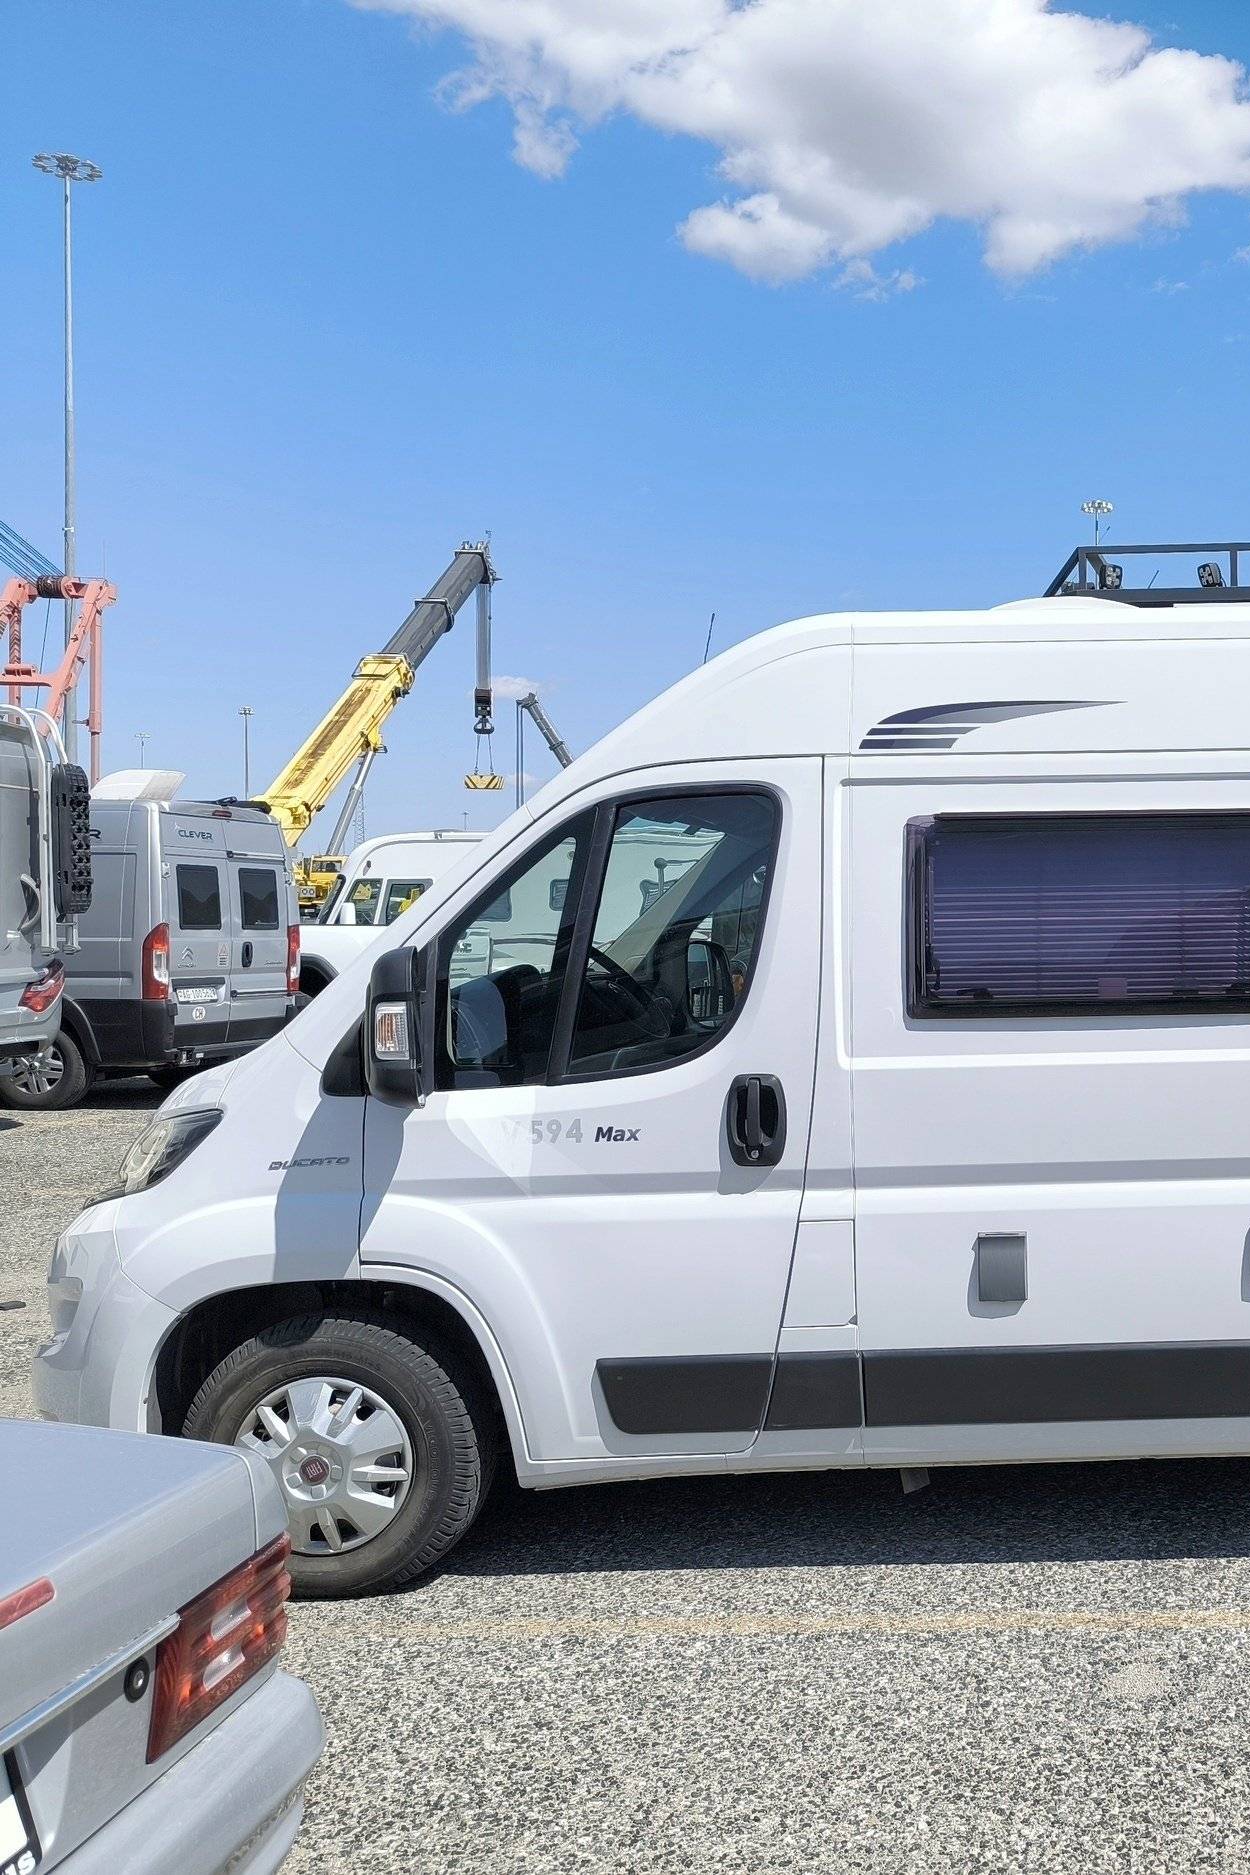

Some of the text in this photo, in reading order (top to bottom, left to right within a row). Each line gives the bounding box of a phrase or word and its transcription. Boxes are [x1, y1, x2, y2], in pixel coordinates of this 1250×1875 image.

[178, 829, 214, 841] CLEVER
[531, 1118, 583, 1145] 594
[594, 1126, 641, 1143] Max
[267, 1156, 350, 1171] DUCATO
[304, 1462, 323, 1479] FIAT
